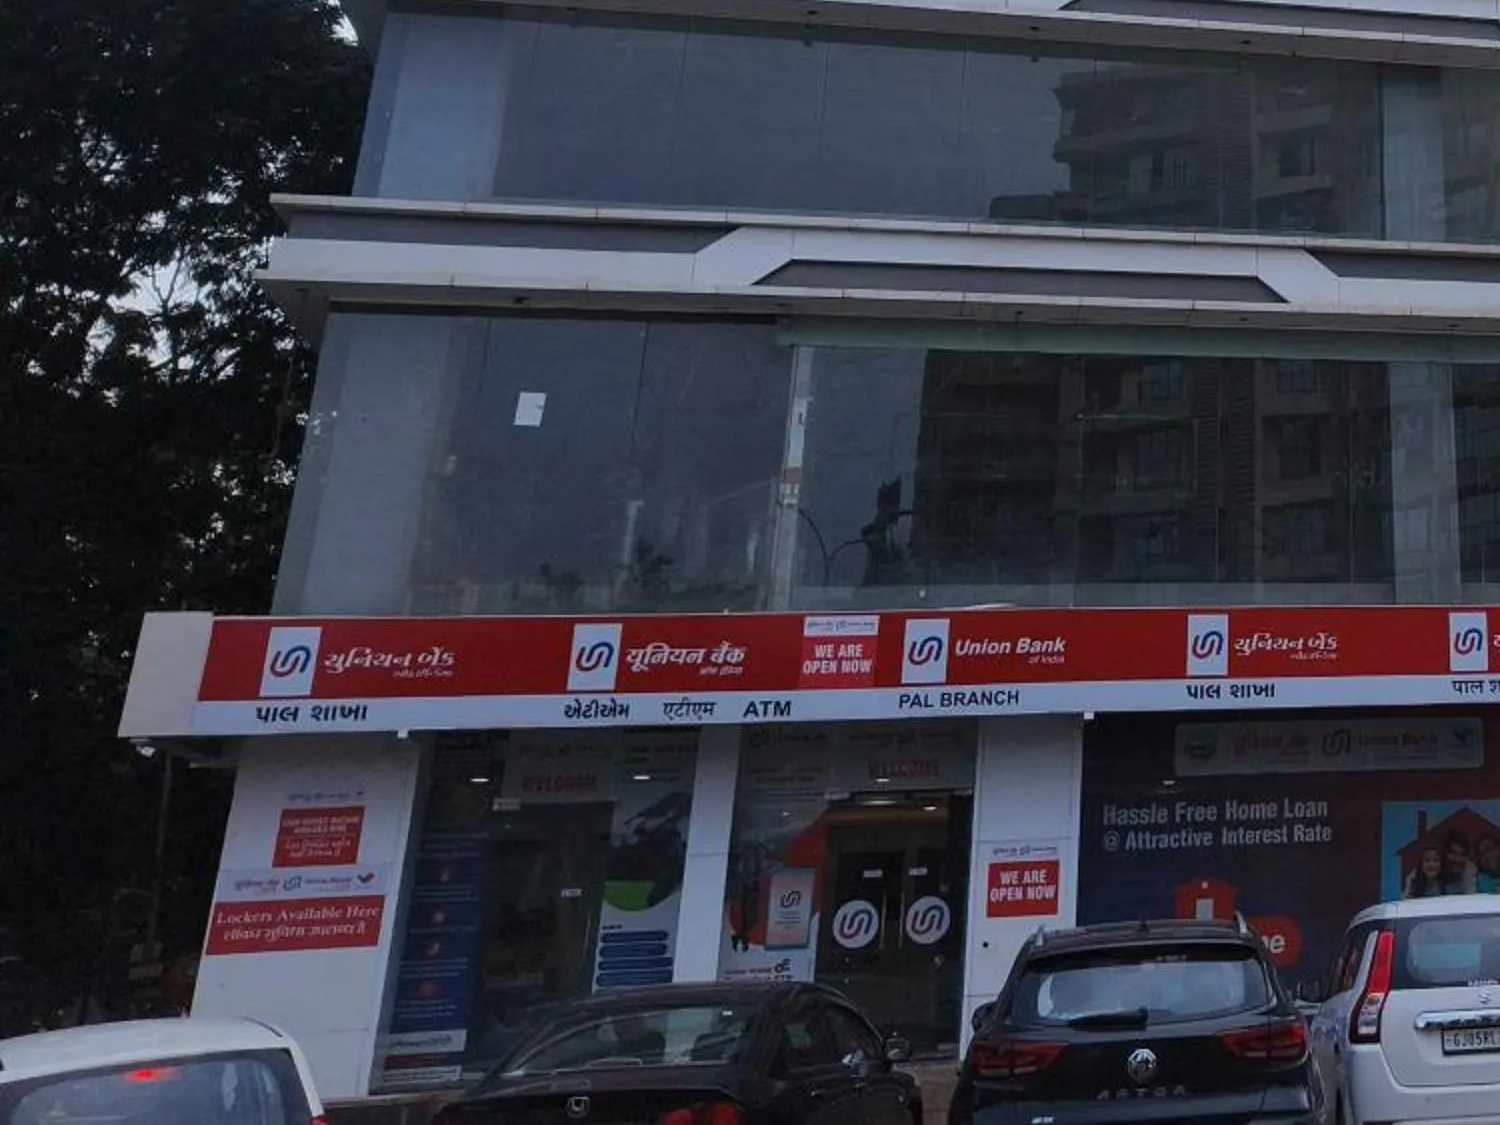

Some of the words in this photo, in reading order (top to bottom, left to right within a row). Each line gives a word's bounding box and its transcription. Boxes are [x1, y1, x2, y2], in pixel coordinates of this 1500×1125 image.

[814, 644, 834, 659] WE
[838, 643, 864, 658] ARE
[955, 639, 1011, 656] Union
[1015, 636, 1067, 654] Bank
[626, 642, 707, 672] यूनियन
[803, 659, 837, 674] OPEN
[842, 658, 873, 674] NOW
[1186, 683, 1221, 700] પાલ
[1230, 682, 1275, 699] શાખા
[1451, 678, 1485, 695] पाल
[564, 698, 630, 719] એટીએમ
[662, 697, 717, 720] एटीएम
[899, 692, 934, 709] PAL
[940, 689, 1019, 708] BRANCH
[256, 705, 299, 723] પાલ
[310, 704, 368, 722] શાખા
[743, 700, 792, 718] ATM
[1103, 801, 1168, 826] Hassle
[1175, 800, 1217, 822] Free
[1225, 799, 1277, 821] Home
[1283, 798, 1328, 819] Loan
[1103, 832, 1120, 852] @
[1125, 828, 1213, 851] Attractive
[1222, 825, 1288, 846] Interest
[1293, 823, 1332, 843] Rate
[999, 871, 1019, 885] WE
[1022, 869, 1047, 884] ARE
[990, 887, 1022, 902] OPEN
[1027, 885, 1056, 901] NOW
